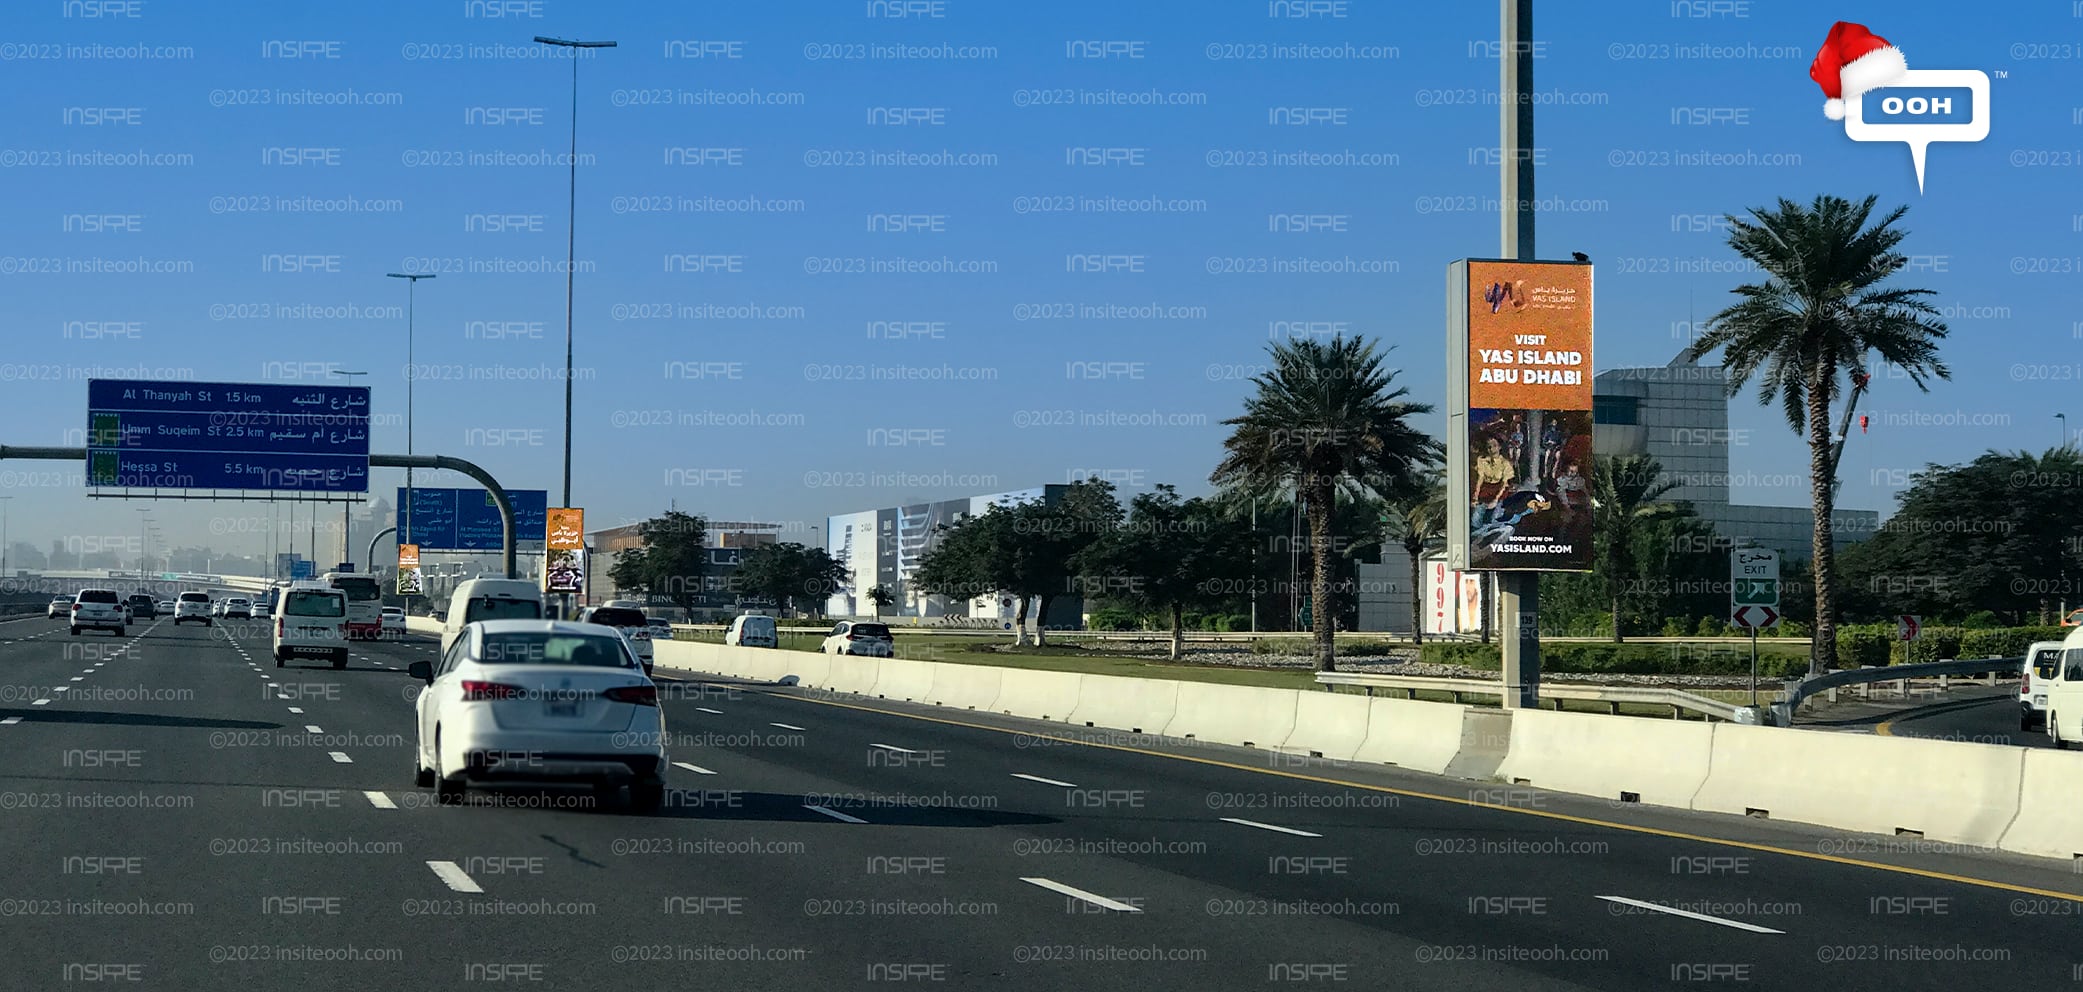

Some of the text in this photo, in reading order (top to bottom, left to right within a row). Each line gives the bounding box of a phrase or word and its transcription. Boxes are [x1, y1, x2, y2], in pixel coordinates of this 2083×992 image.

[1548, 295, 1576, 303] ISLAND
[1514, 334, 1547, 346] VISIT
[1479, 349, 1582, 366] YAS ISLAND
[1479, 368, 1582, 386] ABU DHABI
[123, 389, 212, 403] Al Thanyah St
[225, 391, 261, 403] 1.5 km
[330, 394, 367, 410] شارع
[122, 423, 221, 438] Umm Suqeim St
[226, 426, 265, 438] 2.5 km
[330, 428, 365, 444] شارع
[121, 461, 178, 473] Hessa St
[224, 463, 263, 474] 5.5 km
[328, 465, 364, 481] شارع
[1490, 543, 1573, 554] YASISLAND.COM
[1744, 565, 1767, 574] EXIT
